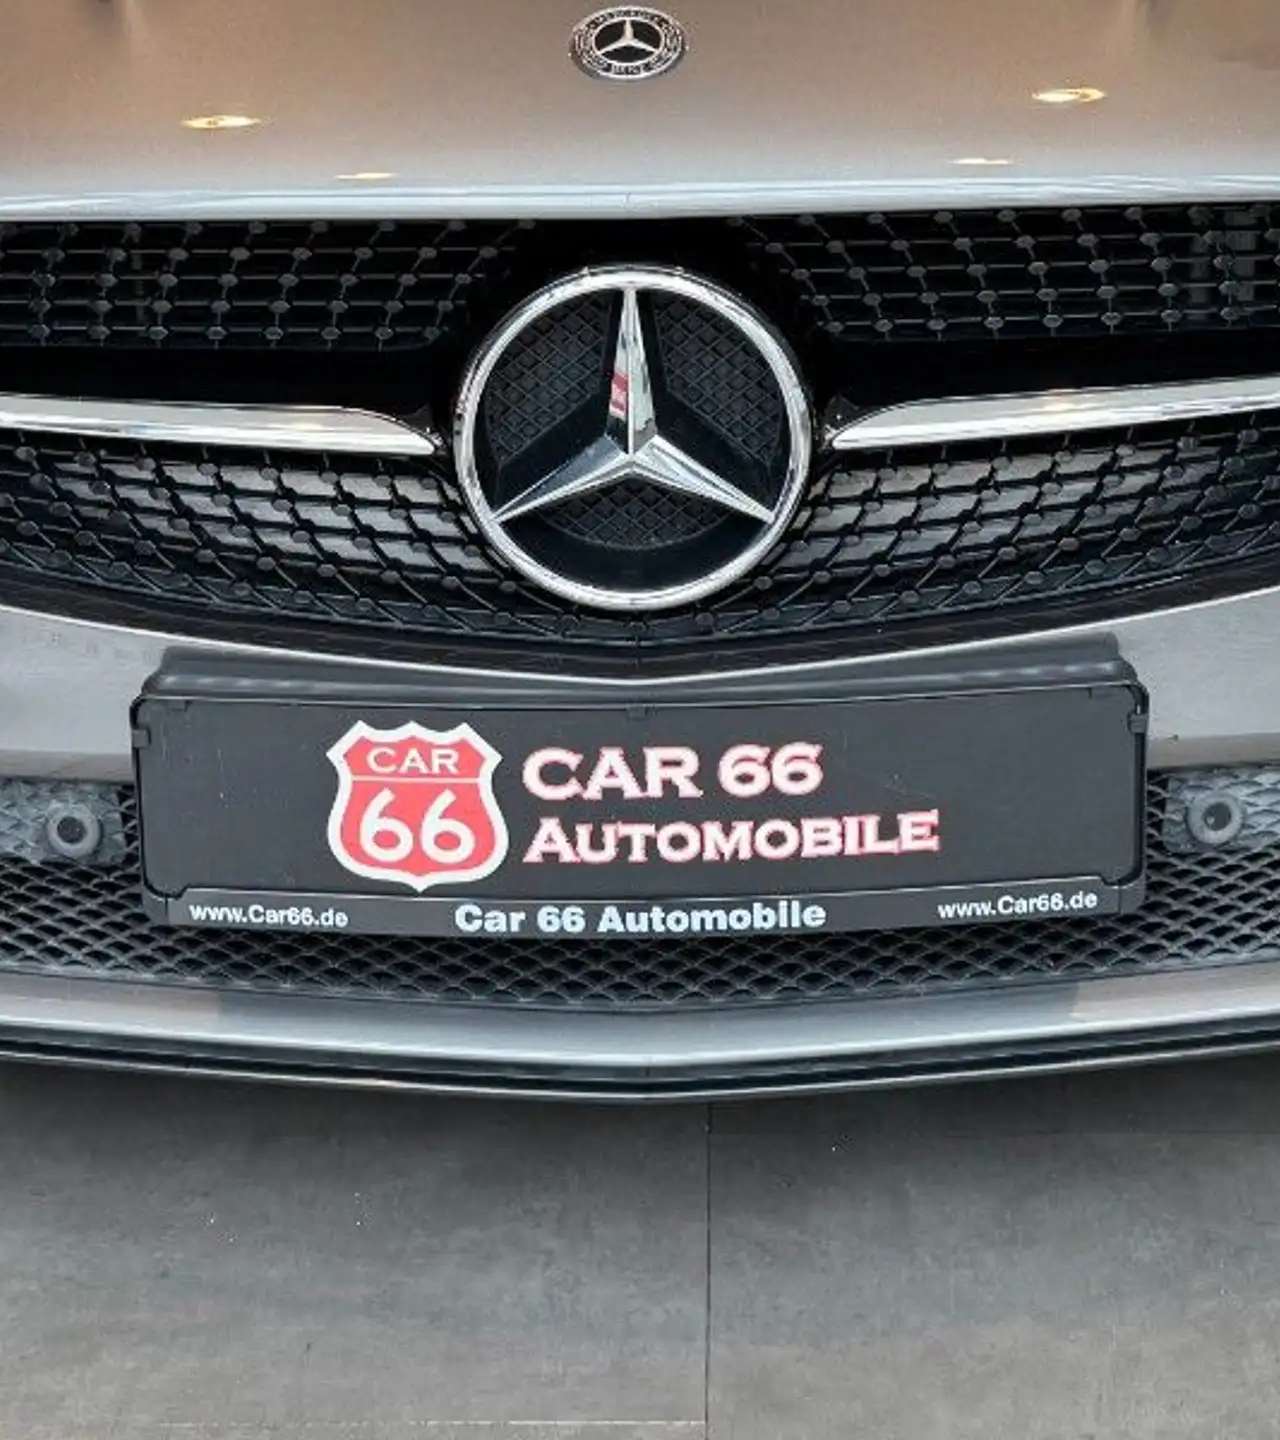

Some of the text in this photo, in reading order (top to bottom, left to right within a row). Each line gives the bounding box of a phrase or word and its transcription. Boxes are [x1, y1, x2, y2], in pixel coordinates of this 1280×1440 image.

[366, 746, 460, 775] CAR
[521, 741, 824, 801] CAR 66
[359, 787, 476, 864] 66
[522, 808, 940, 864] AUTOMOBILE
[188, 903, 349, 928] www.Car66.de
[454, 900, 827, 934] Car 66 Automobile
[936, 890, 1099, 919] www.Car66.de
